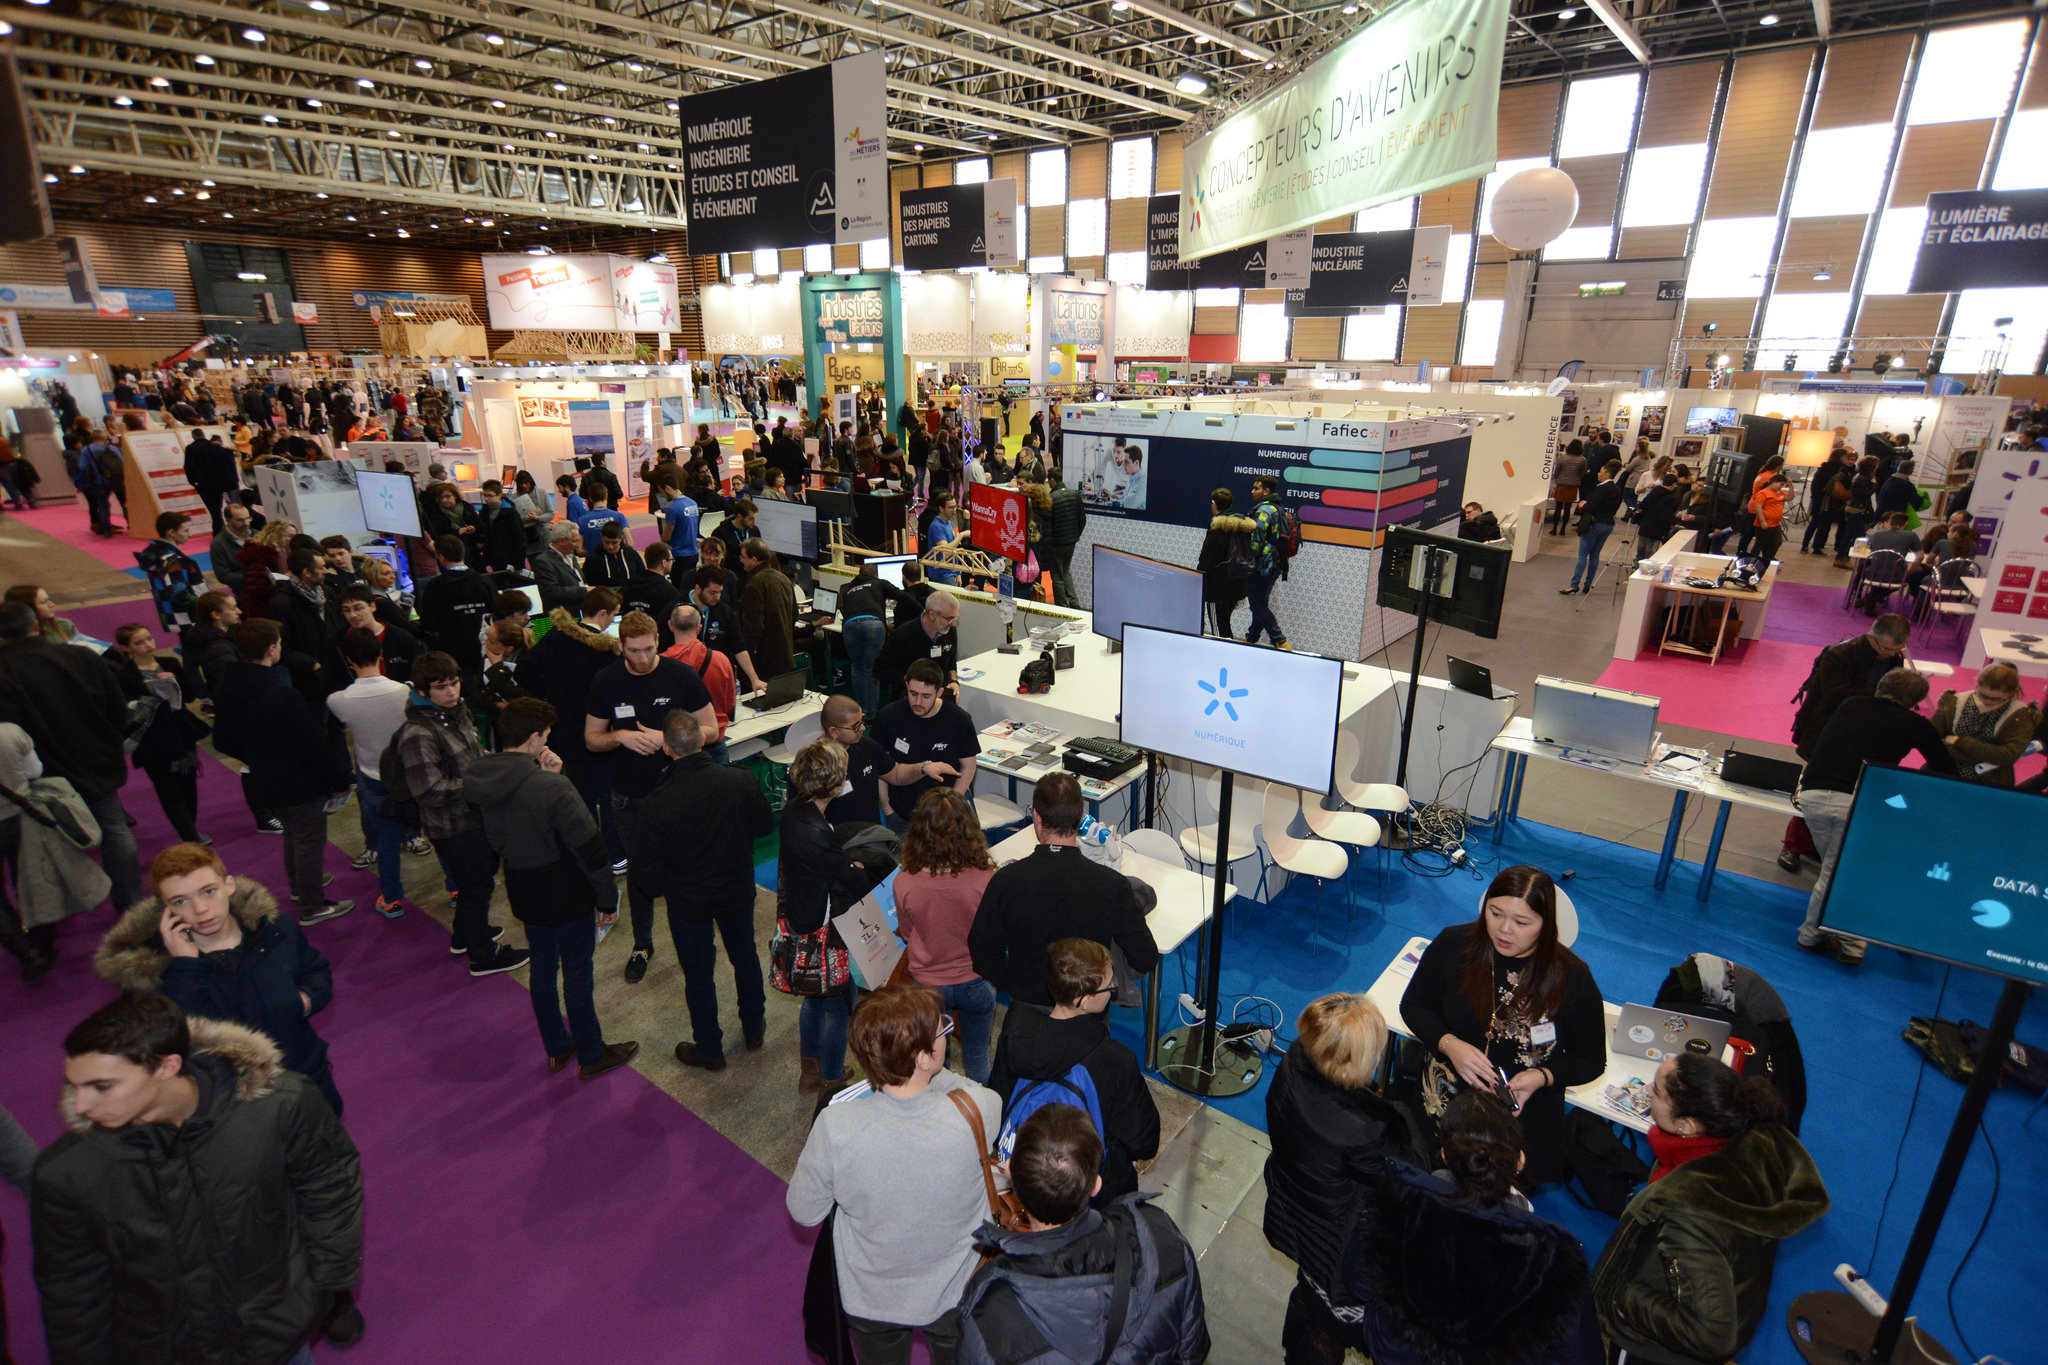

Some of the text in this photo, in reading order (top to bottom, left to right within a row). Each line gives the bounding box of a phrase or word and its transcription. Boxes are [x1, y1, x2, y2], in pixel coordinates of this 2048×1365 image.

[1208, 20, 1477, 198] CONCEPTEURS D'AVENIRS
[687, 116, 753, 144] NUMÉRIQUE
[1331, 144, 1377, 180] CONSEIL
[1385, 103, 1471, 159] ÉVÉNEMENT
[689, 144, 751, 170] INGÉNIERIE
[691, 163, 800, 195] ÉTUDES ET CONSEIL
[692, 196, 758, 219] ÉVÉNEMENT
[902, 201, 949, 217] INDUSTRIES
[1929, 204, 2012, 226] LUMIÈRE
[903, 216, 951, 233] DES PAPIERS
[1924, 222, 2048, 245] ET ÉCLAIRAGE
[903, 232, 938, 247] CARTONS
[1150, 245, 1162, 256] LA
[1312, 245, 1365, 258] INDUSTRIE
[1311, 258, 1363, 272] NUCLÉAIRE
[1658, 288, 1684, 299] 4.19
[820, 293, 883, 320] Industries
[1057, 293, 1098, 321] Cartons
[849, 320, 883, 337] Cartons
[1322, 422, 1369, 439] Fafiec
[1257, 449, 1308, 461] NUMERIQUE
[1541, 416, 1560, 480] CONFERENCE
[1233, 466, 1281, 477] INGENIERIE
[1286, 489, 1320, 500] ETUDES
[971, 501, 998, 520] WannaCry
[1194, 729, 1247, 749] NUMÉRIQUE
[1992, 875, 2040, 897] DATA
[1985, 949, 2022, 965] Exemple
[2026, 959, 2036, 968] le
